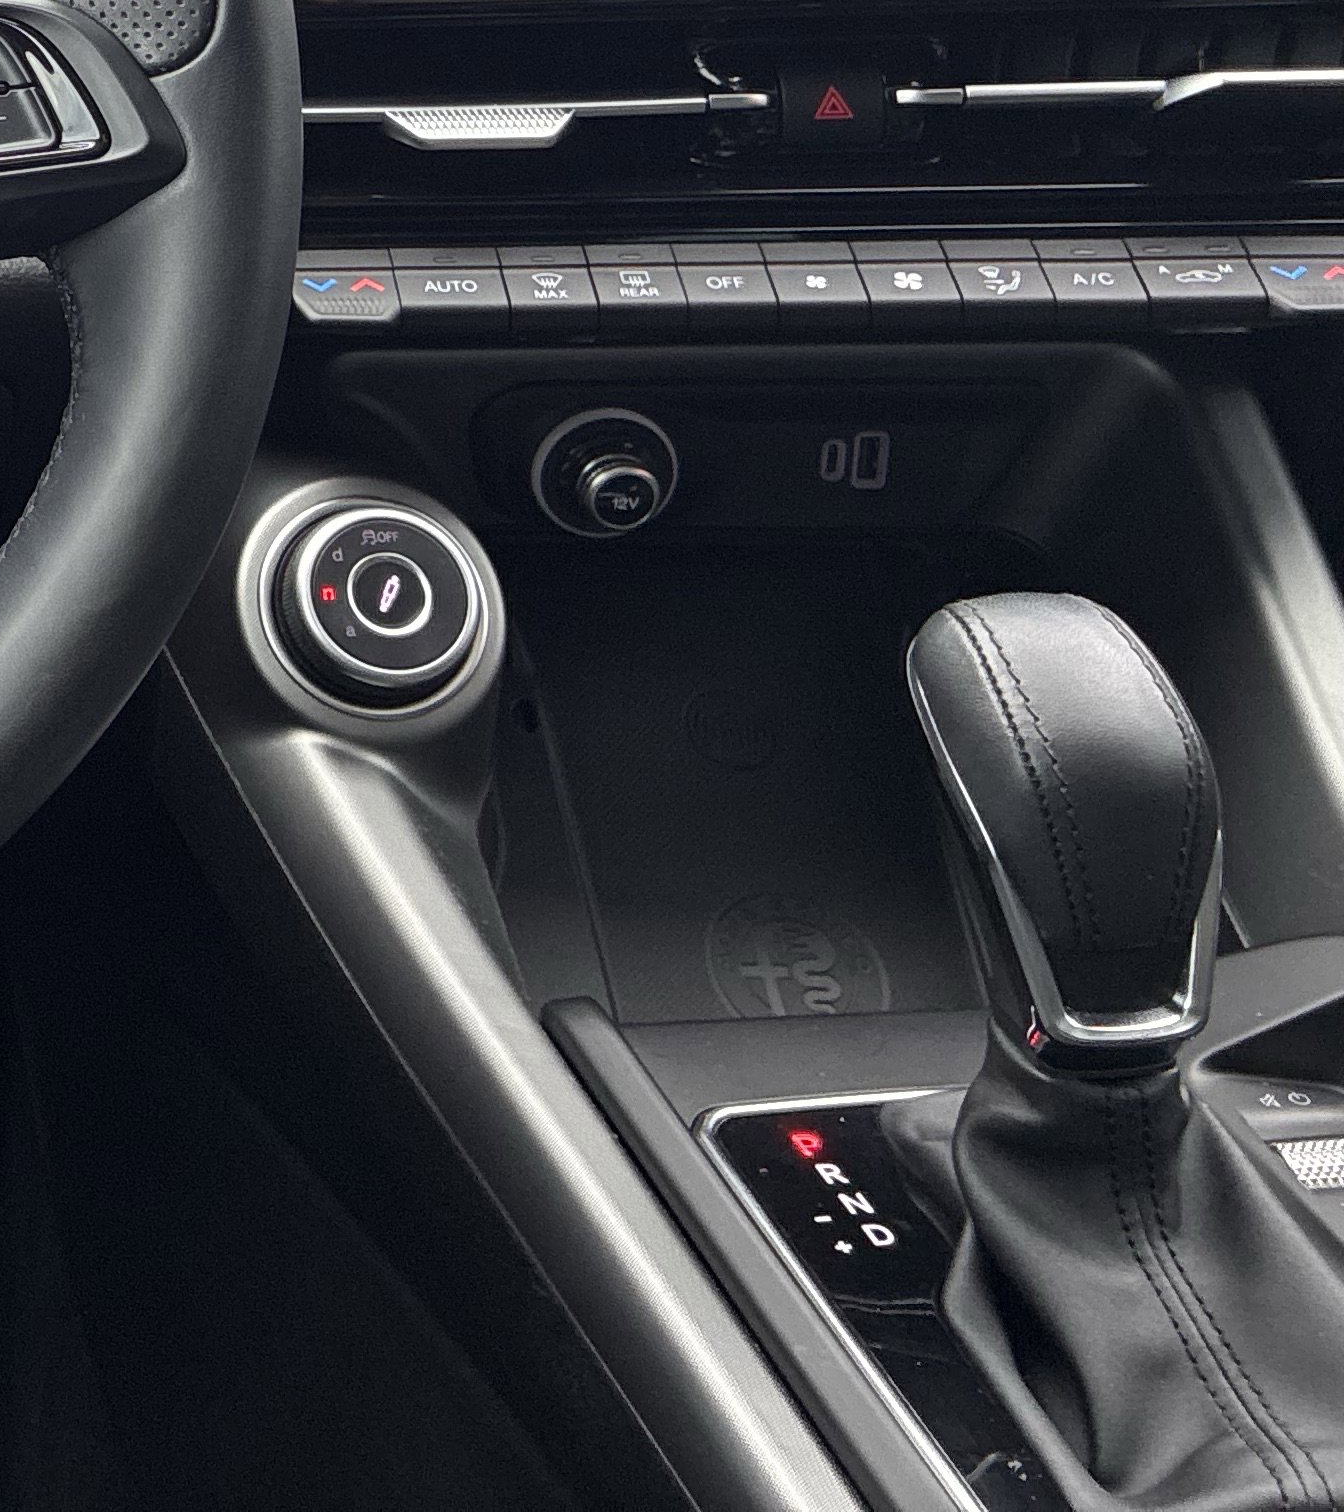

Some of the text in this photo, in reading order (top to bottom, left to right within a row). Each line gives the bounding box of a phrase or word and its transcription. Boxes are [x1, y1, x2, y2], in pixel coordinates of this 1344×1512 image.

[1217, 263, 1234, 274] M
[424, 279, 478, 293] AUTO
[706, 276, 744, 289] OFF
[1073, 272, 1114, 286] A/C
[534, 289, 568, 299] MAX
[619, 288, 659, 298] REAR
[376, 532, 398, 543] OFF
[790, 1133, 820, 1157] P
[814, 1163, 850, 1185] R
[837, 1192, 875, 1215] N
[861, 1223, 895, 1247] D
